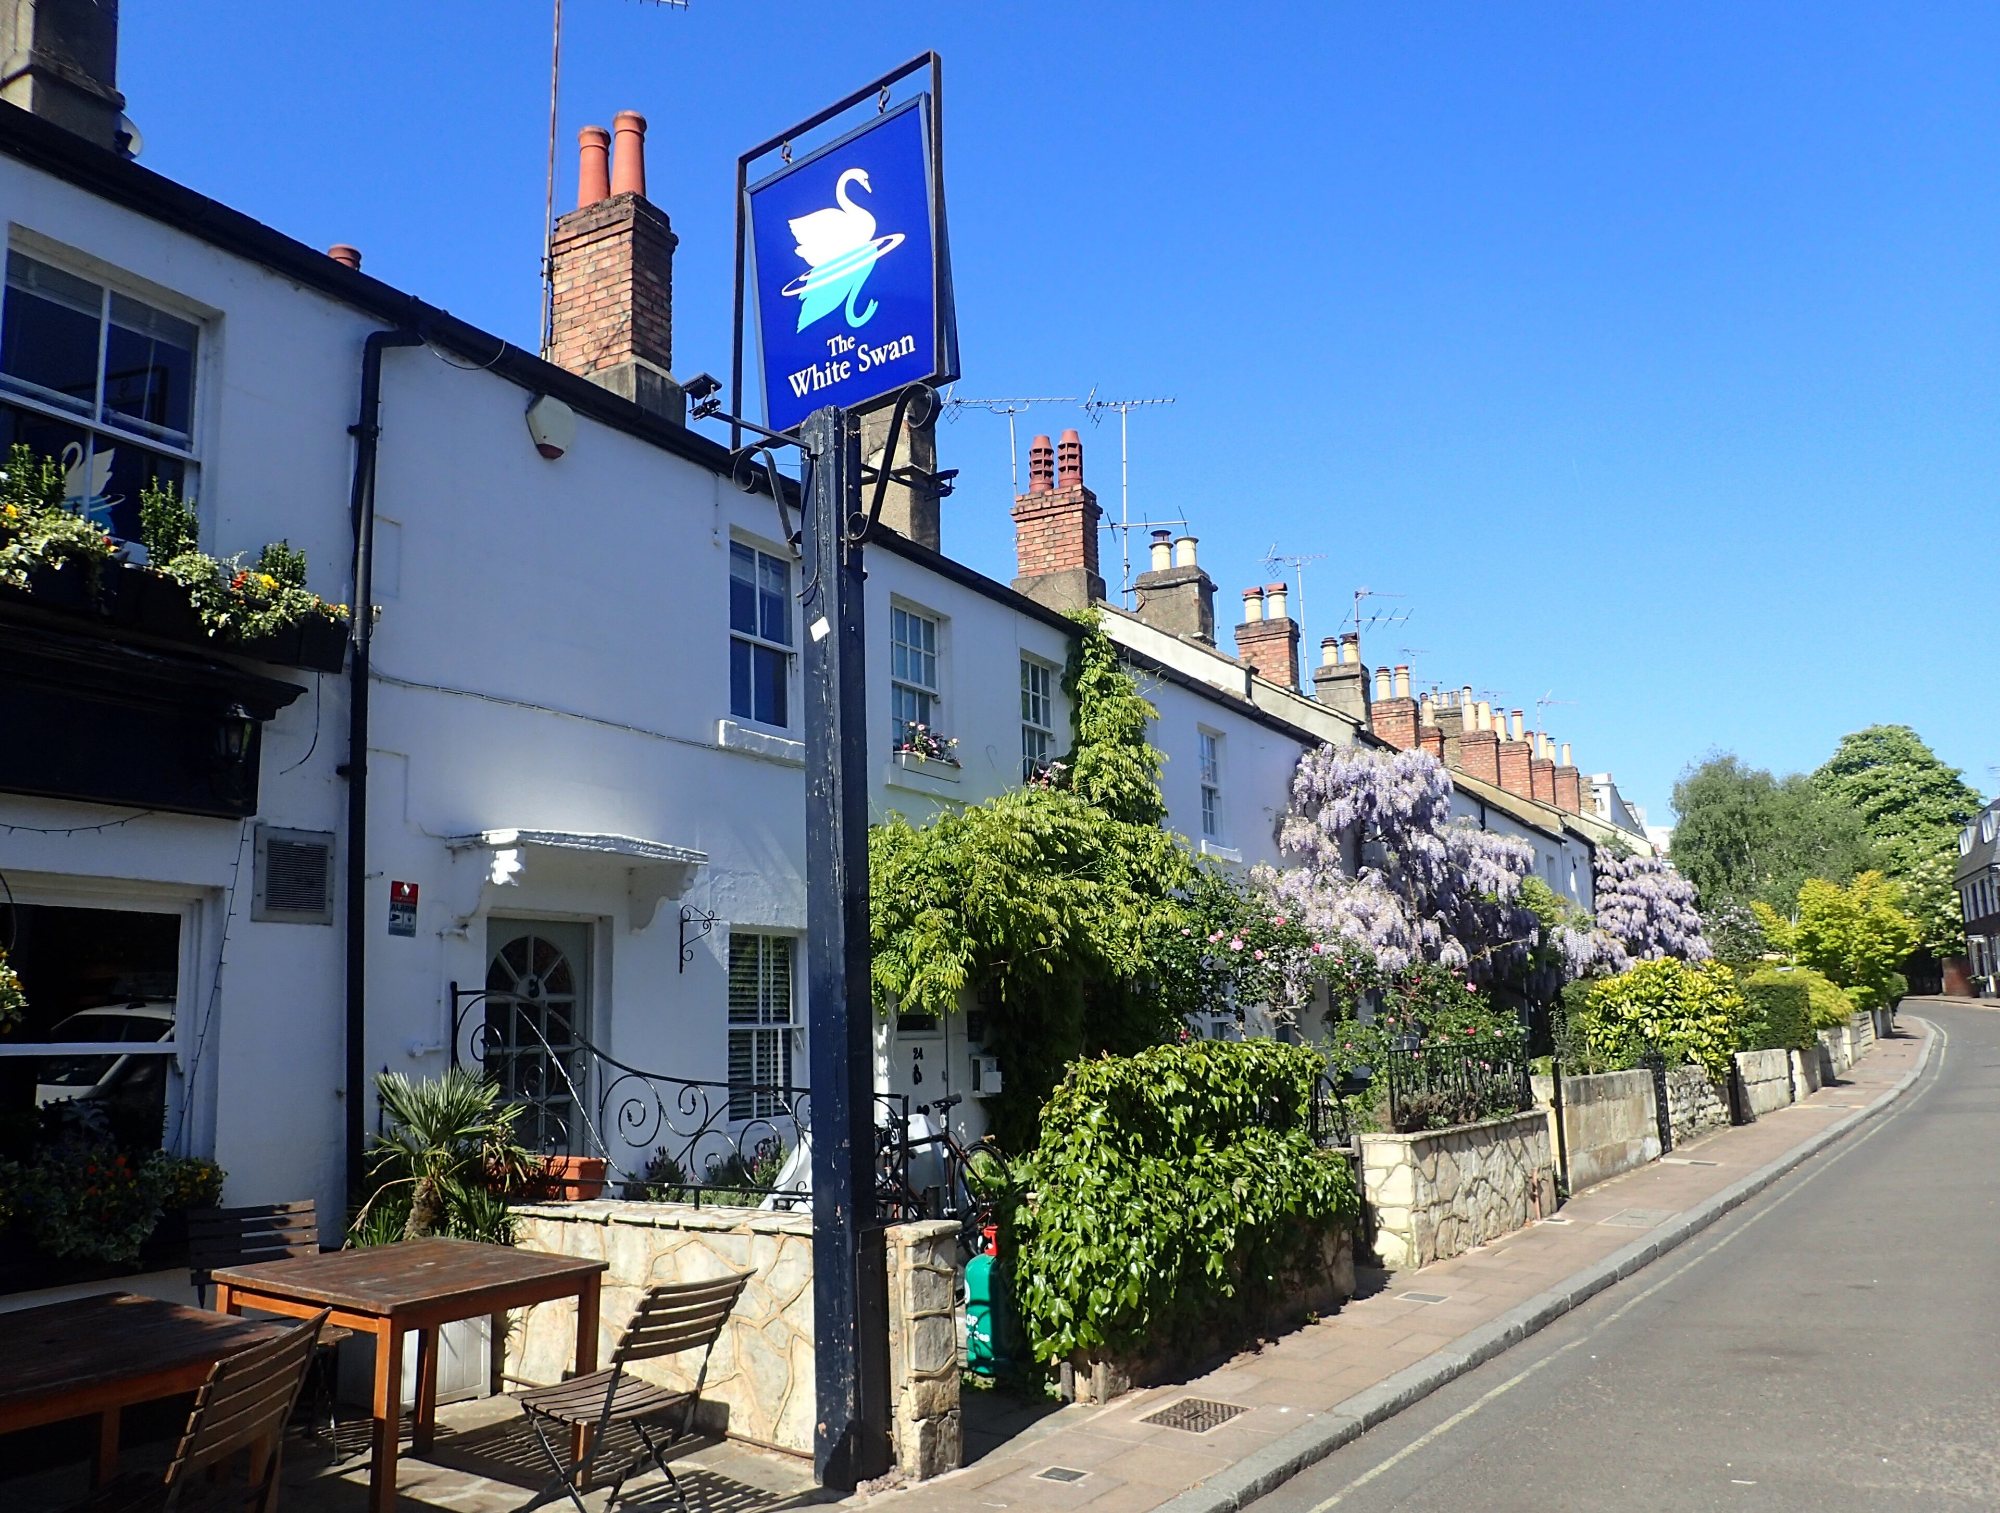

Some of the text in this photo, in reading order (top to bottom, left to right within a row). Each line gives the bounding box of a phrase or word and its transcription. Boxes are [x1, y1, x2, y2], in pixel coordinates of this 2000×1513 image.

[827, 334, 855, 357] The
[788, 335, 916, 398] White Swan
[913, 1047, 923, 1060] 24
